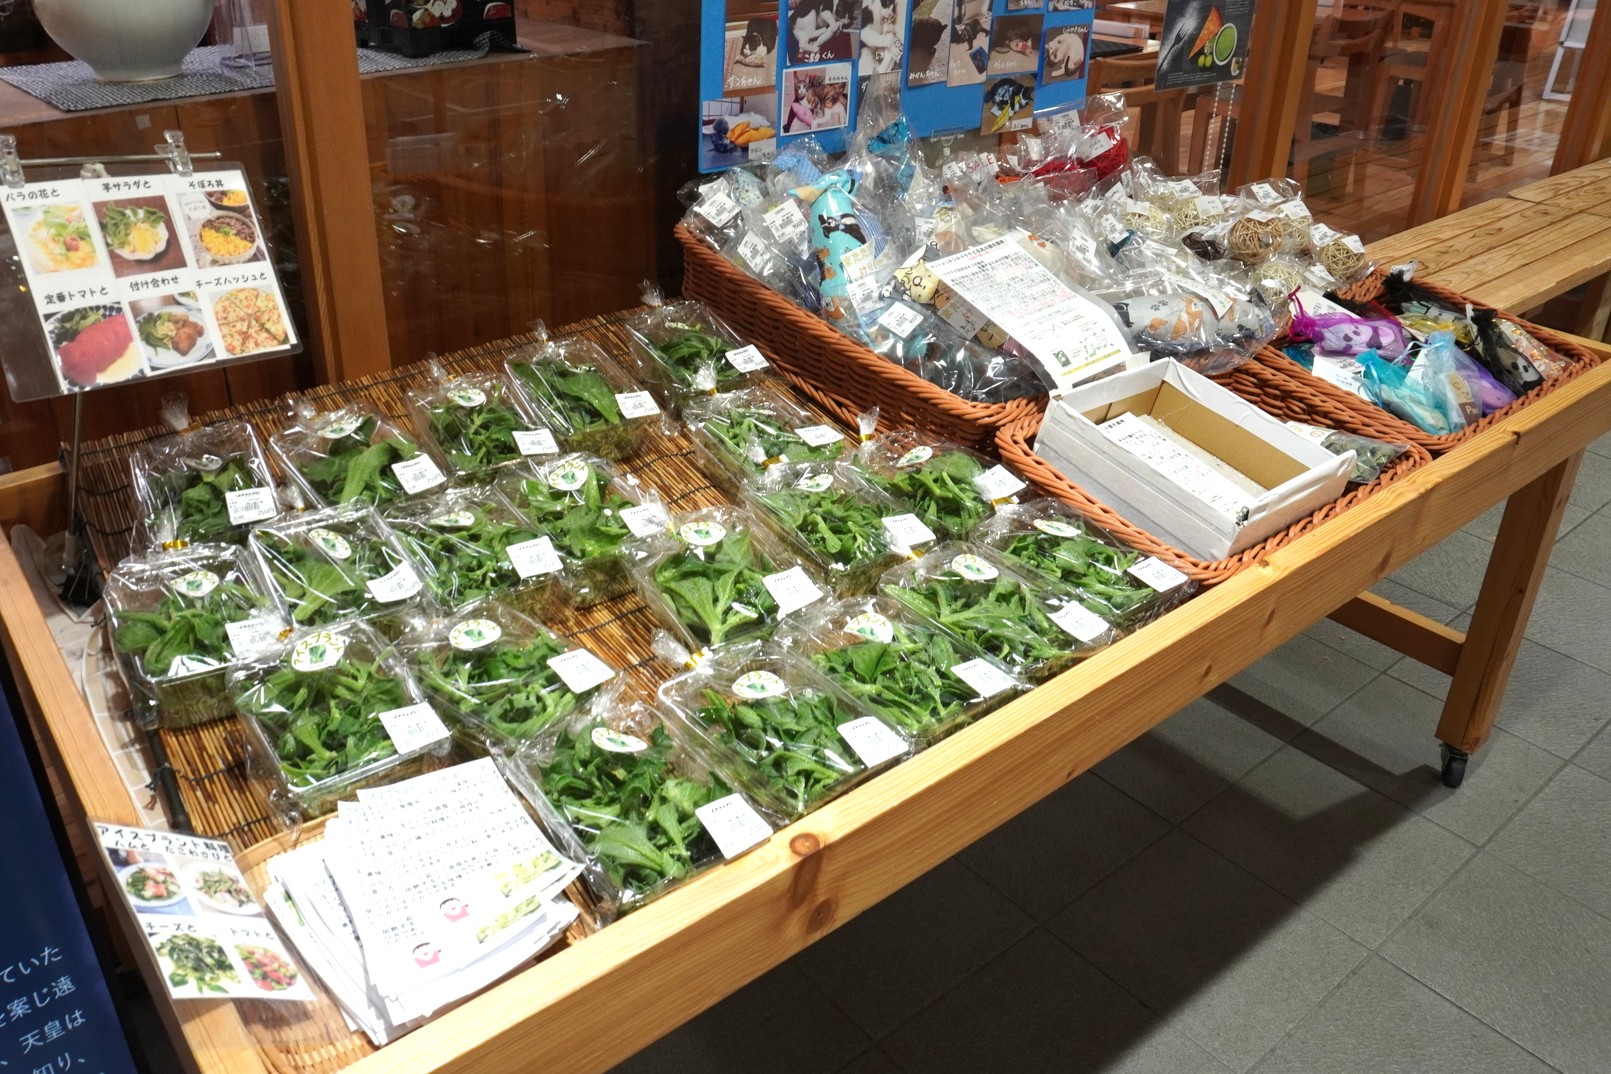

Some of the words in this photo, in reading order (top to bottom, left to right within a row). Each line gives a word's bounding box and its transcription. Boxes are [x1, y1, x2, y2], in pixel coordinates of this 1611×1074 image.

[967, 153, 995, 173] SALE
[101, 179, 152, 193] 芋サラダと
[187, 179, 225, 190] そぼろ丼
[129, 274, 180, 292] 付け合わせ
[195, 271, 268, 289] チーズハッシュと
[44, 286, 109, 306] 定番トマトと
[96, 825, 232, 855] アイスプラント料理
[115, 840, 151, 852] ハムと
[145, 922, 198, 933] チーズと
[231, 927, 275, 940] トマトと
